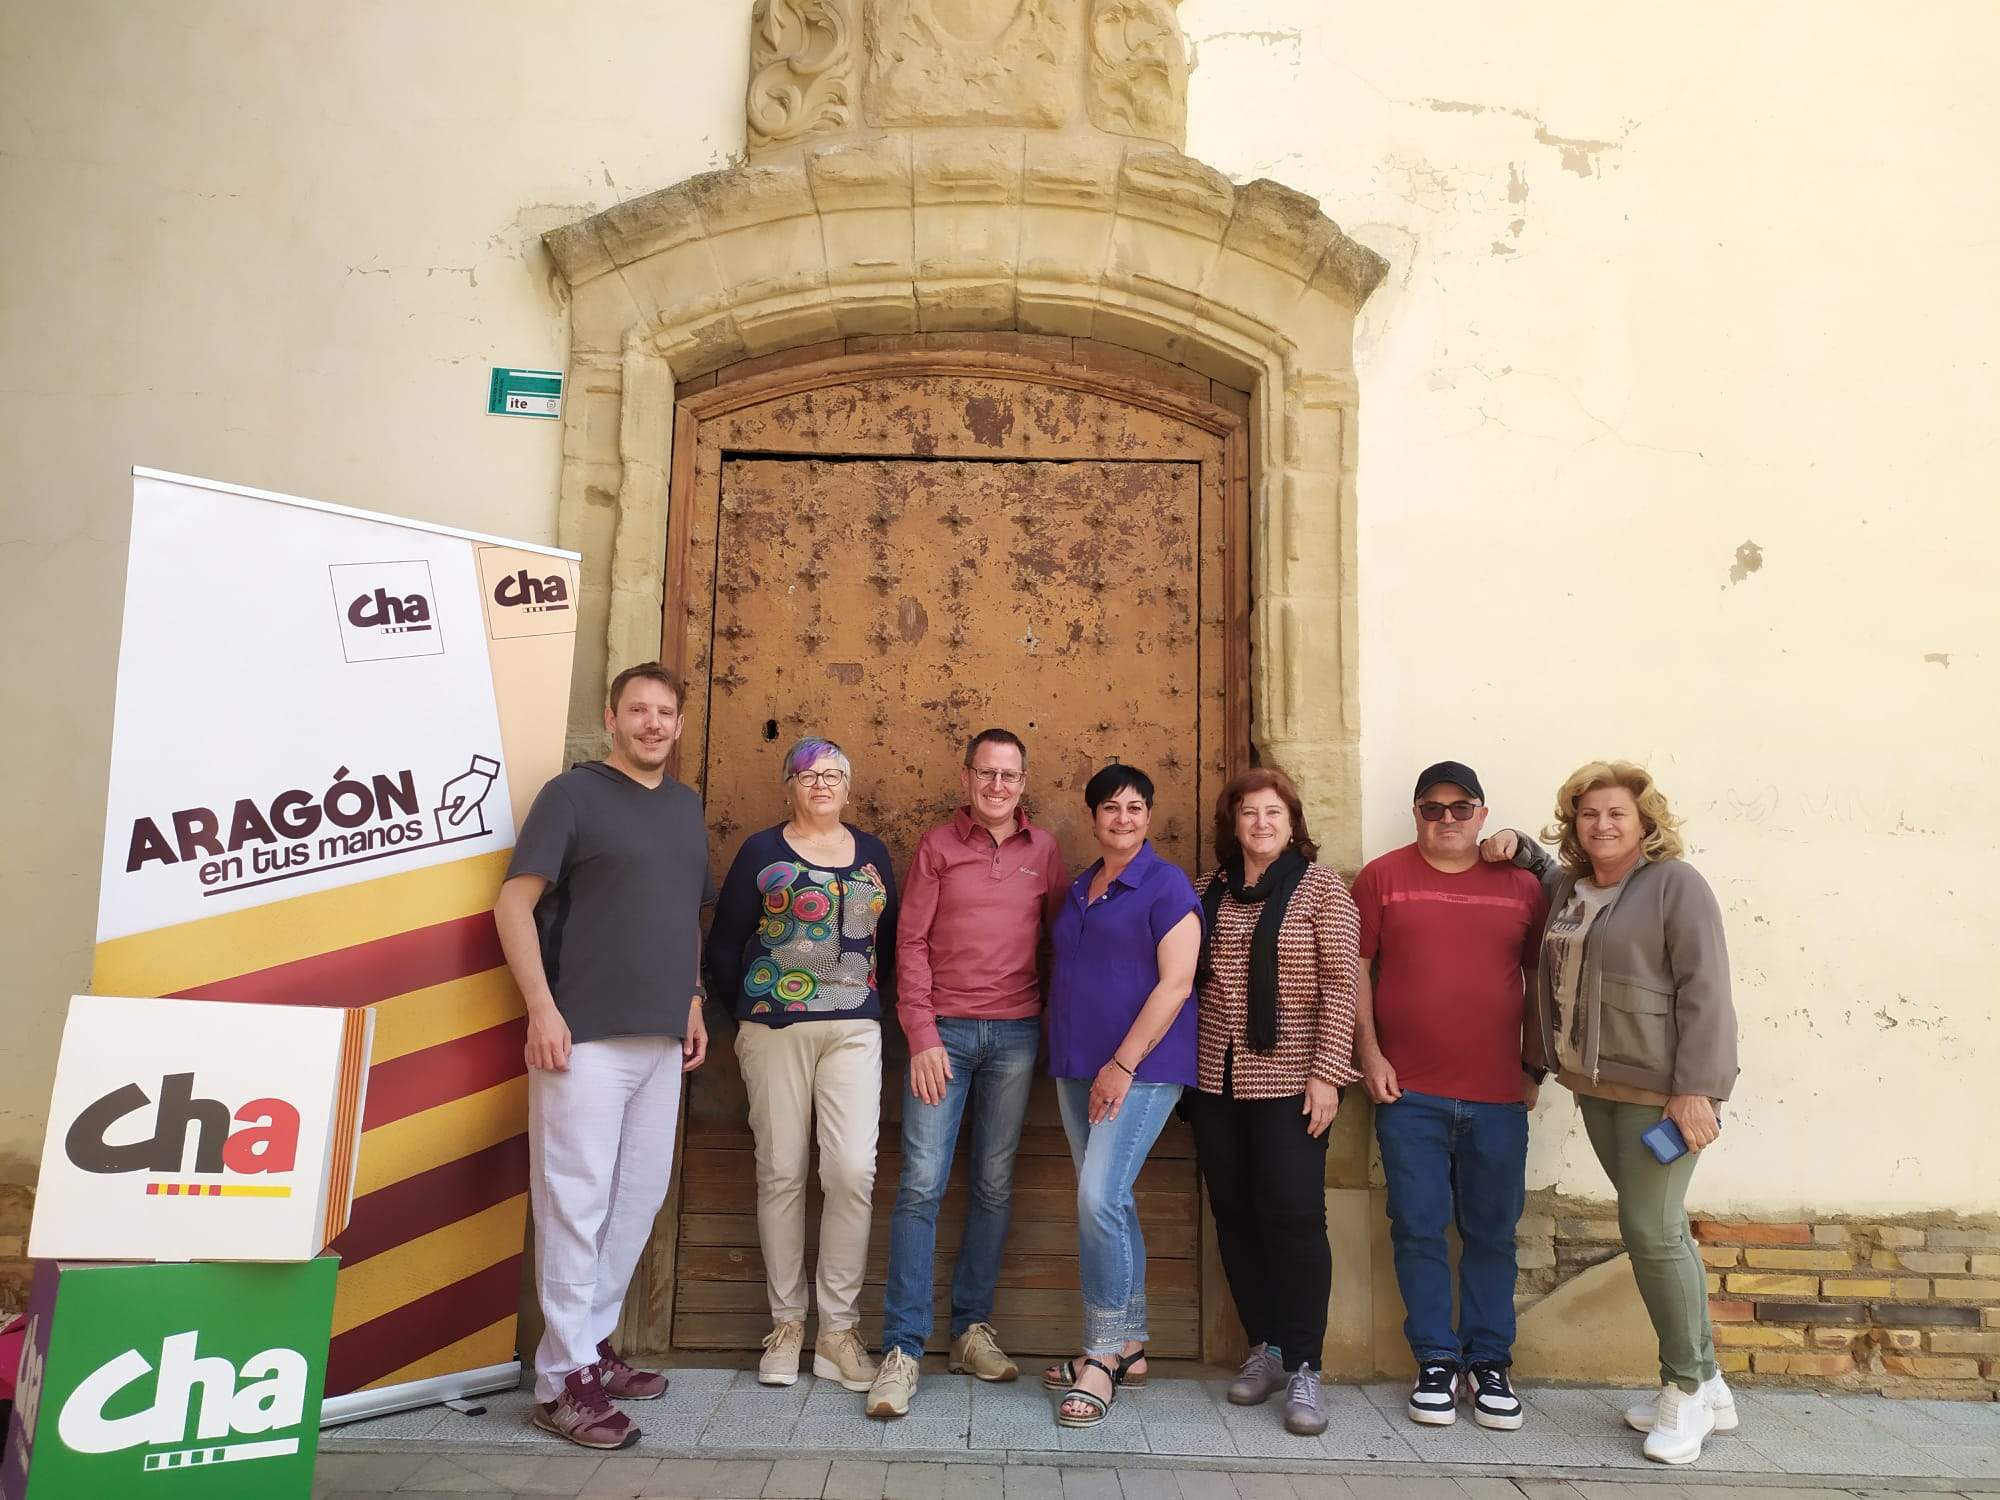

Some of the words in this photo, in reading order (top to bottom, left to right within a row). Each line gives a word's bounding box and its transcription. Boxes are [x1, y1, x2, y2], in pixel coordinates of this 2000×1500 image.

[348, 588, 430, 628] cha
[495, 570, 568, 607] cha
[125, 766, 420, 873] ARAGÓN
[199, 856, 243, 886] en
[252, 843, 310, 874] tus
[318, 819, 423, 861] manos
[65, 1072, 301, 1175] cha
[58, 1330, 308, 1454] cha
